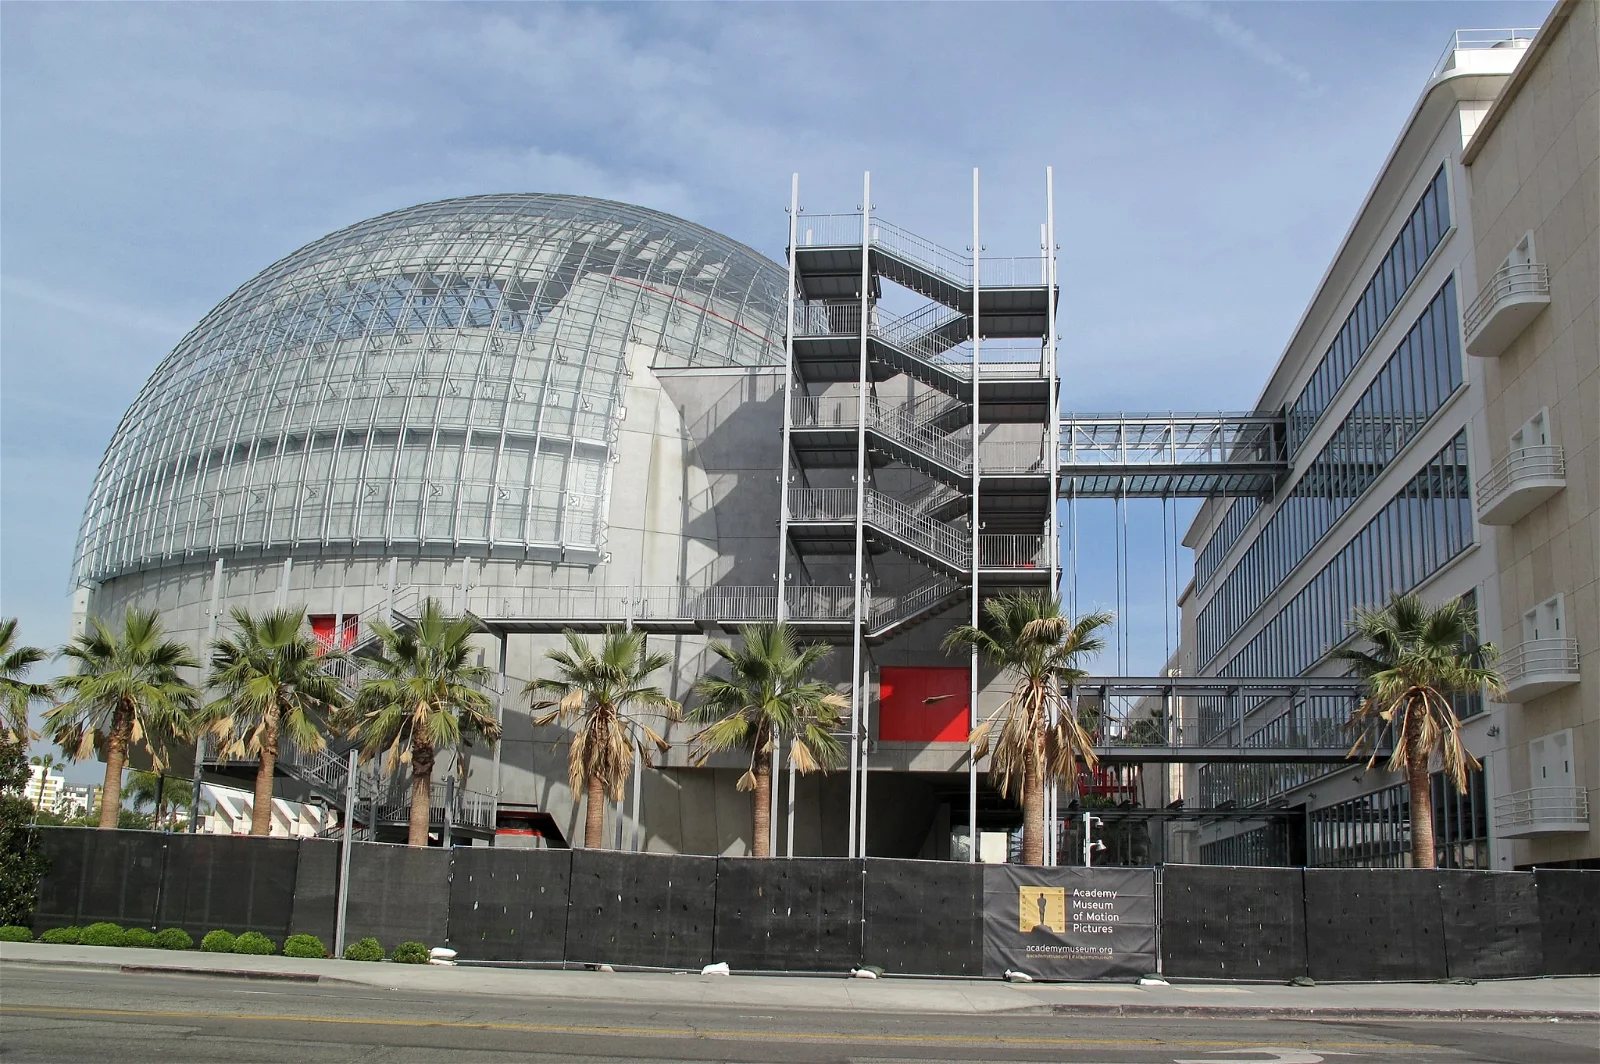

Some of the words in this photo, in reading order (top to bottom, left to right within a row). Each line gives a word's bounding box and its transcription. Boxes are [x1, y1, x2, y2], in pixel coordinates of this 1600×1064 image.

[1073, 888, 1117, 899] Academy
[1073, 900, 1114, 909] Museum
[1073, 912, 1083, 920] of
[1086, 912, 1119, 921] Motion
[1073, 923, 1113, 933] Pictures
[1026, 944, 1113, 954] academymuseum.org
